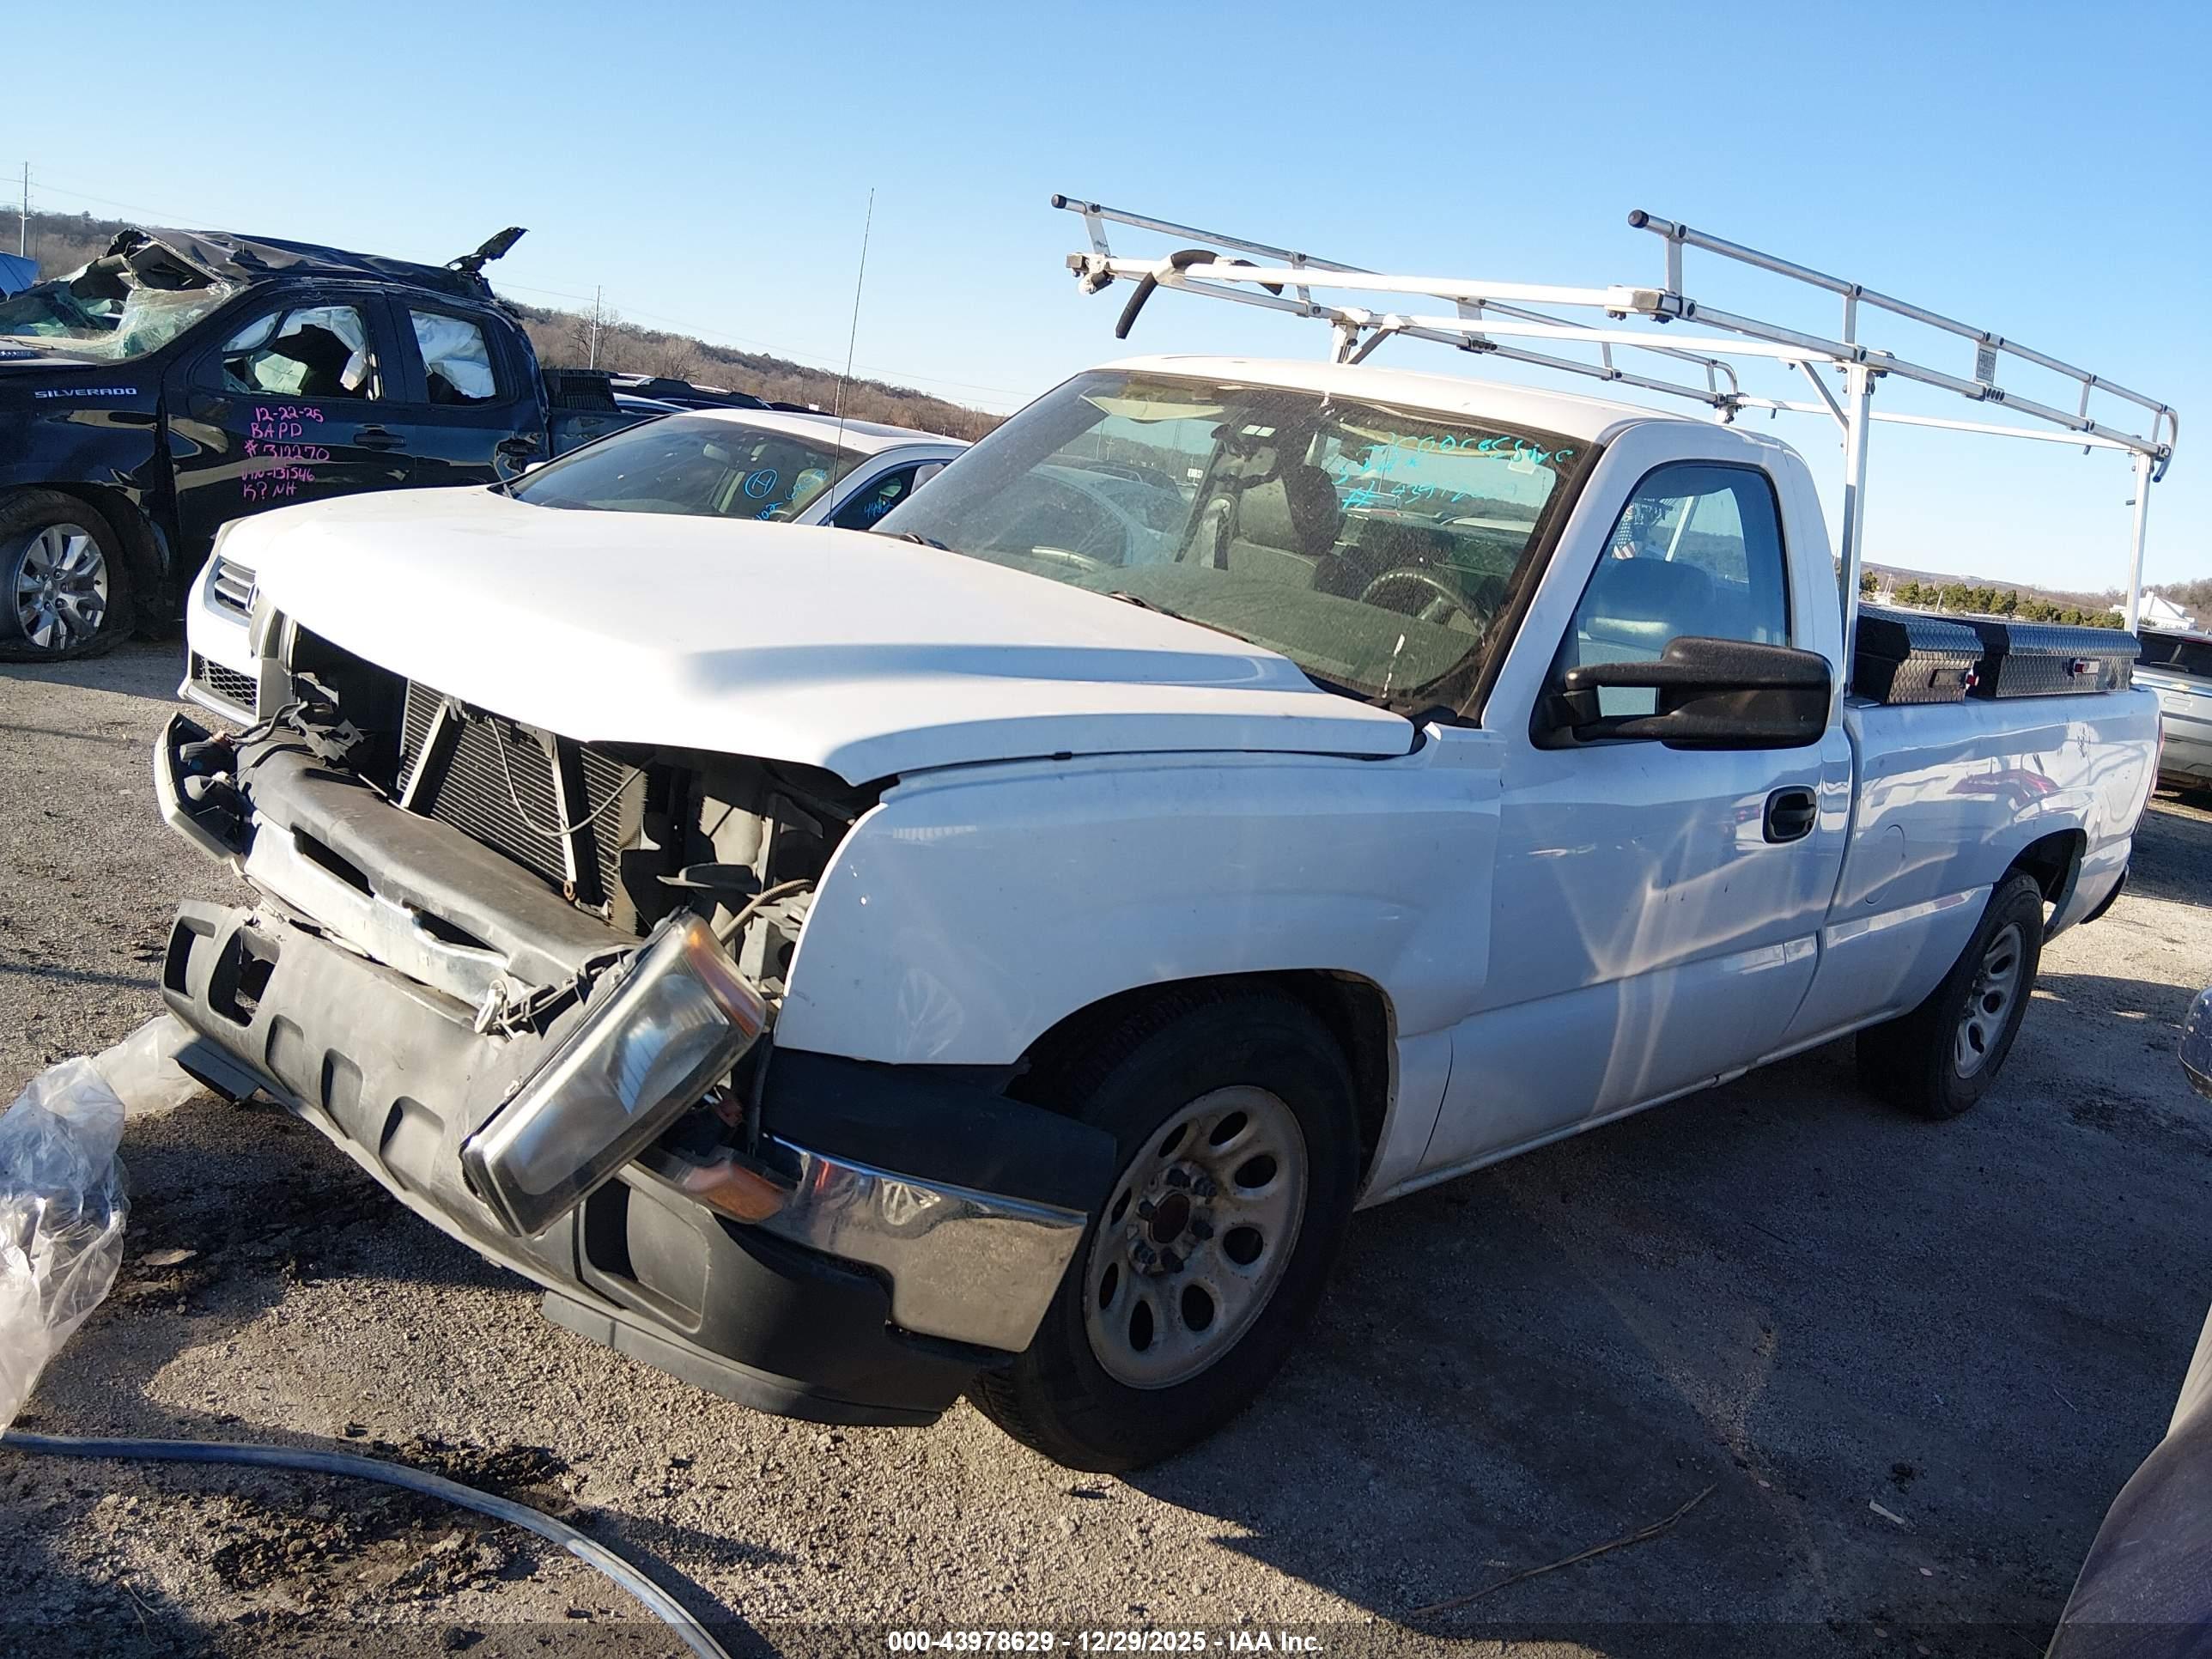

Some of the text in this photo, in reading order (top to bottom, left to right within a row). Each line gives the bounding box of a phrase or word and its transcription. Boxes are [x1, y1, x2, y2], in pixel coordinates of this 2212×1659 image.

[34, 387, 137, 398] SILVERADO
[255, 405, 324, 422] 12-22-25
[263, 444, 330, 462] 312270
